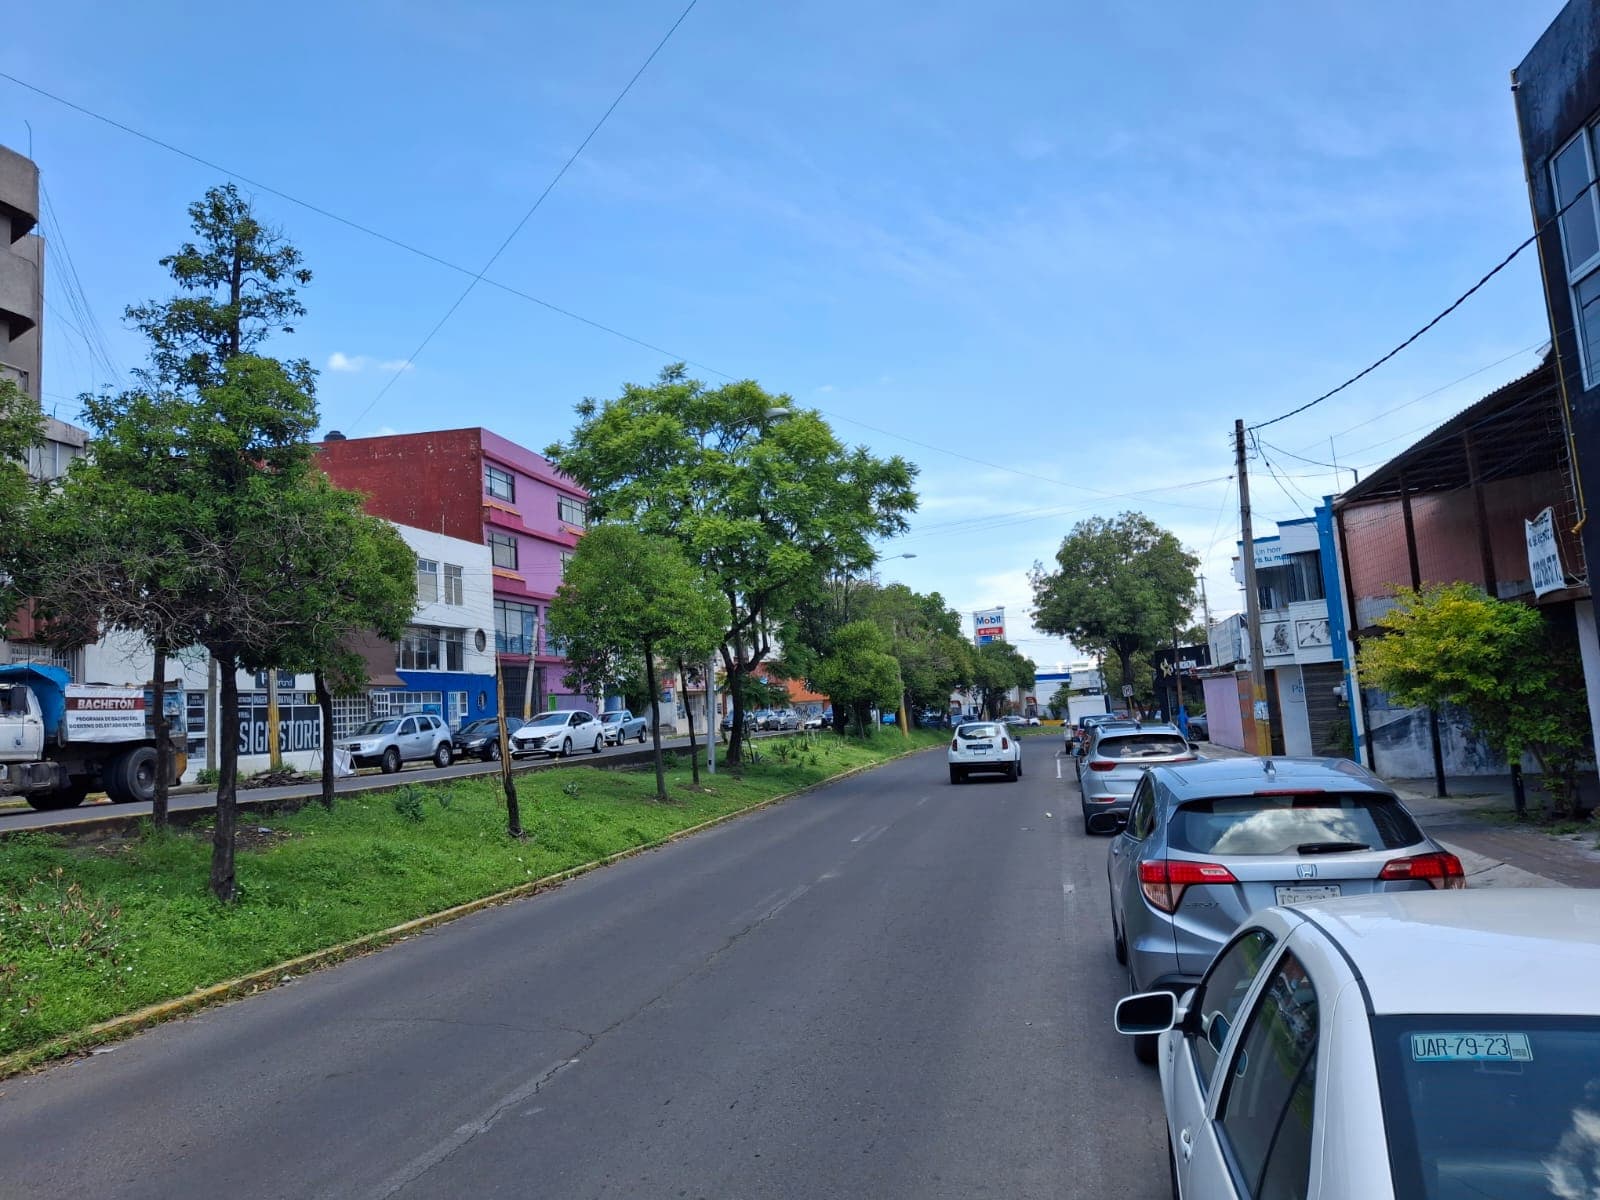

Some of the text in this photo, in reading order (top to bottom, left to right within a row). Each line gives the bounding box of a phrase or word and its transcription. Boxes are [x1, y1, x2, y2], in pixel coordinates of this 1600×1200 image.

[976, 615, 1001, 625] Mobil
[77, 697, 135, 710] BACHETÓN
[279, 719, 320, 752] STORE
[1415, 1038, 1508, 1057] UAR-79-23
